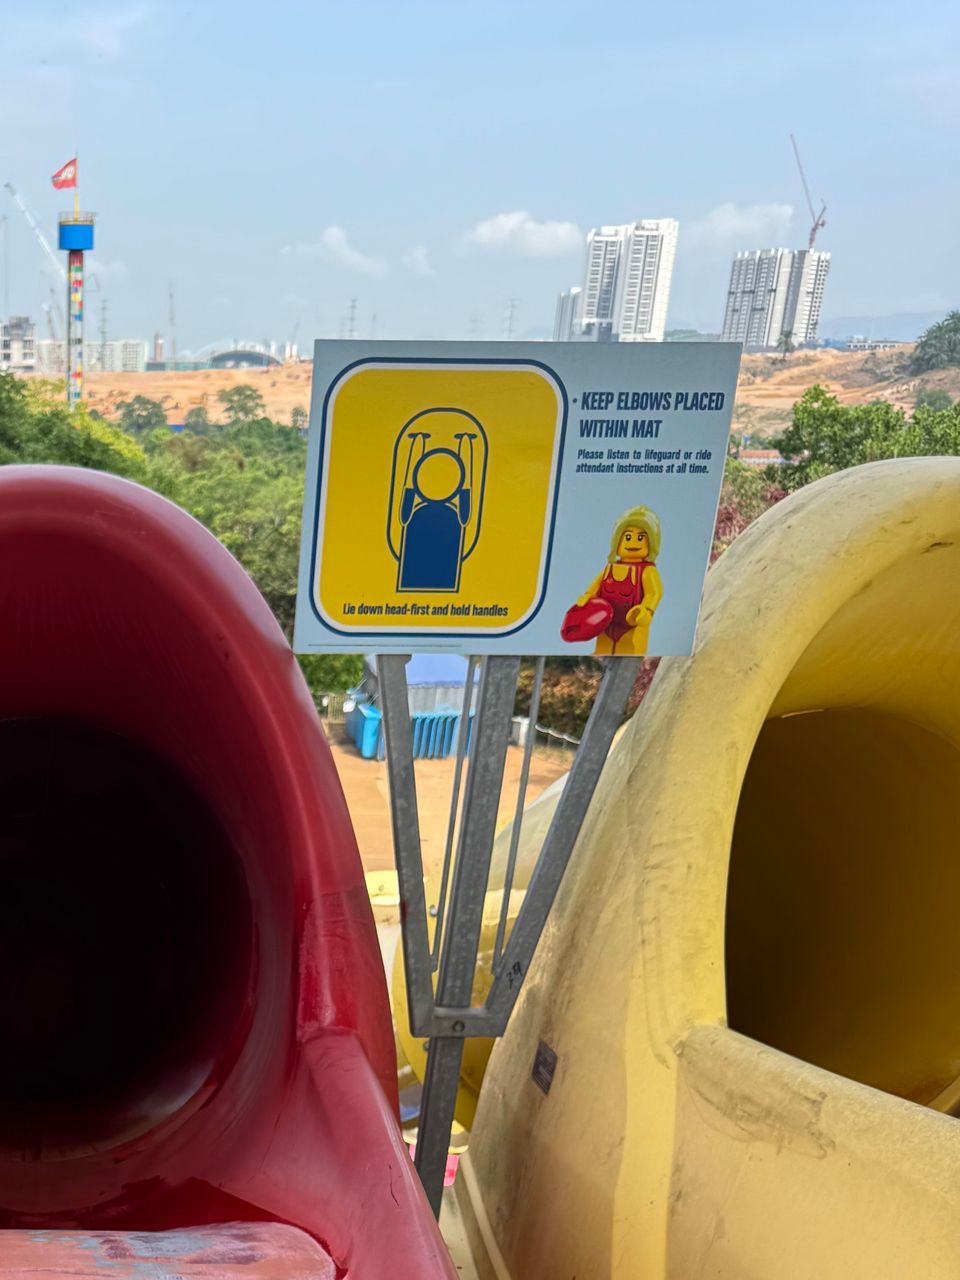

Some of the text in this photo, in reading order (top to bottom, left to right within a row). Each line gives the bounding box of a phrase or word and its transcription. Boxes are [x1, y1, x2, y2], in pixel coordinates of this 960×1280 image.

[581, 391, 725, 411] KEEP ELBOWS PLACED
[580, 419, 663, 438] WITHIN MAT
[577, 449, 712, 462] Please listen to lifeguard or ride
[576, 462, 710, 474] attendant instructions at all time.
[343, 603, 508, 617] Lie down head-first and hold handles
